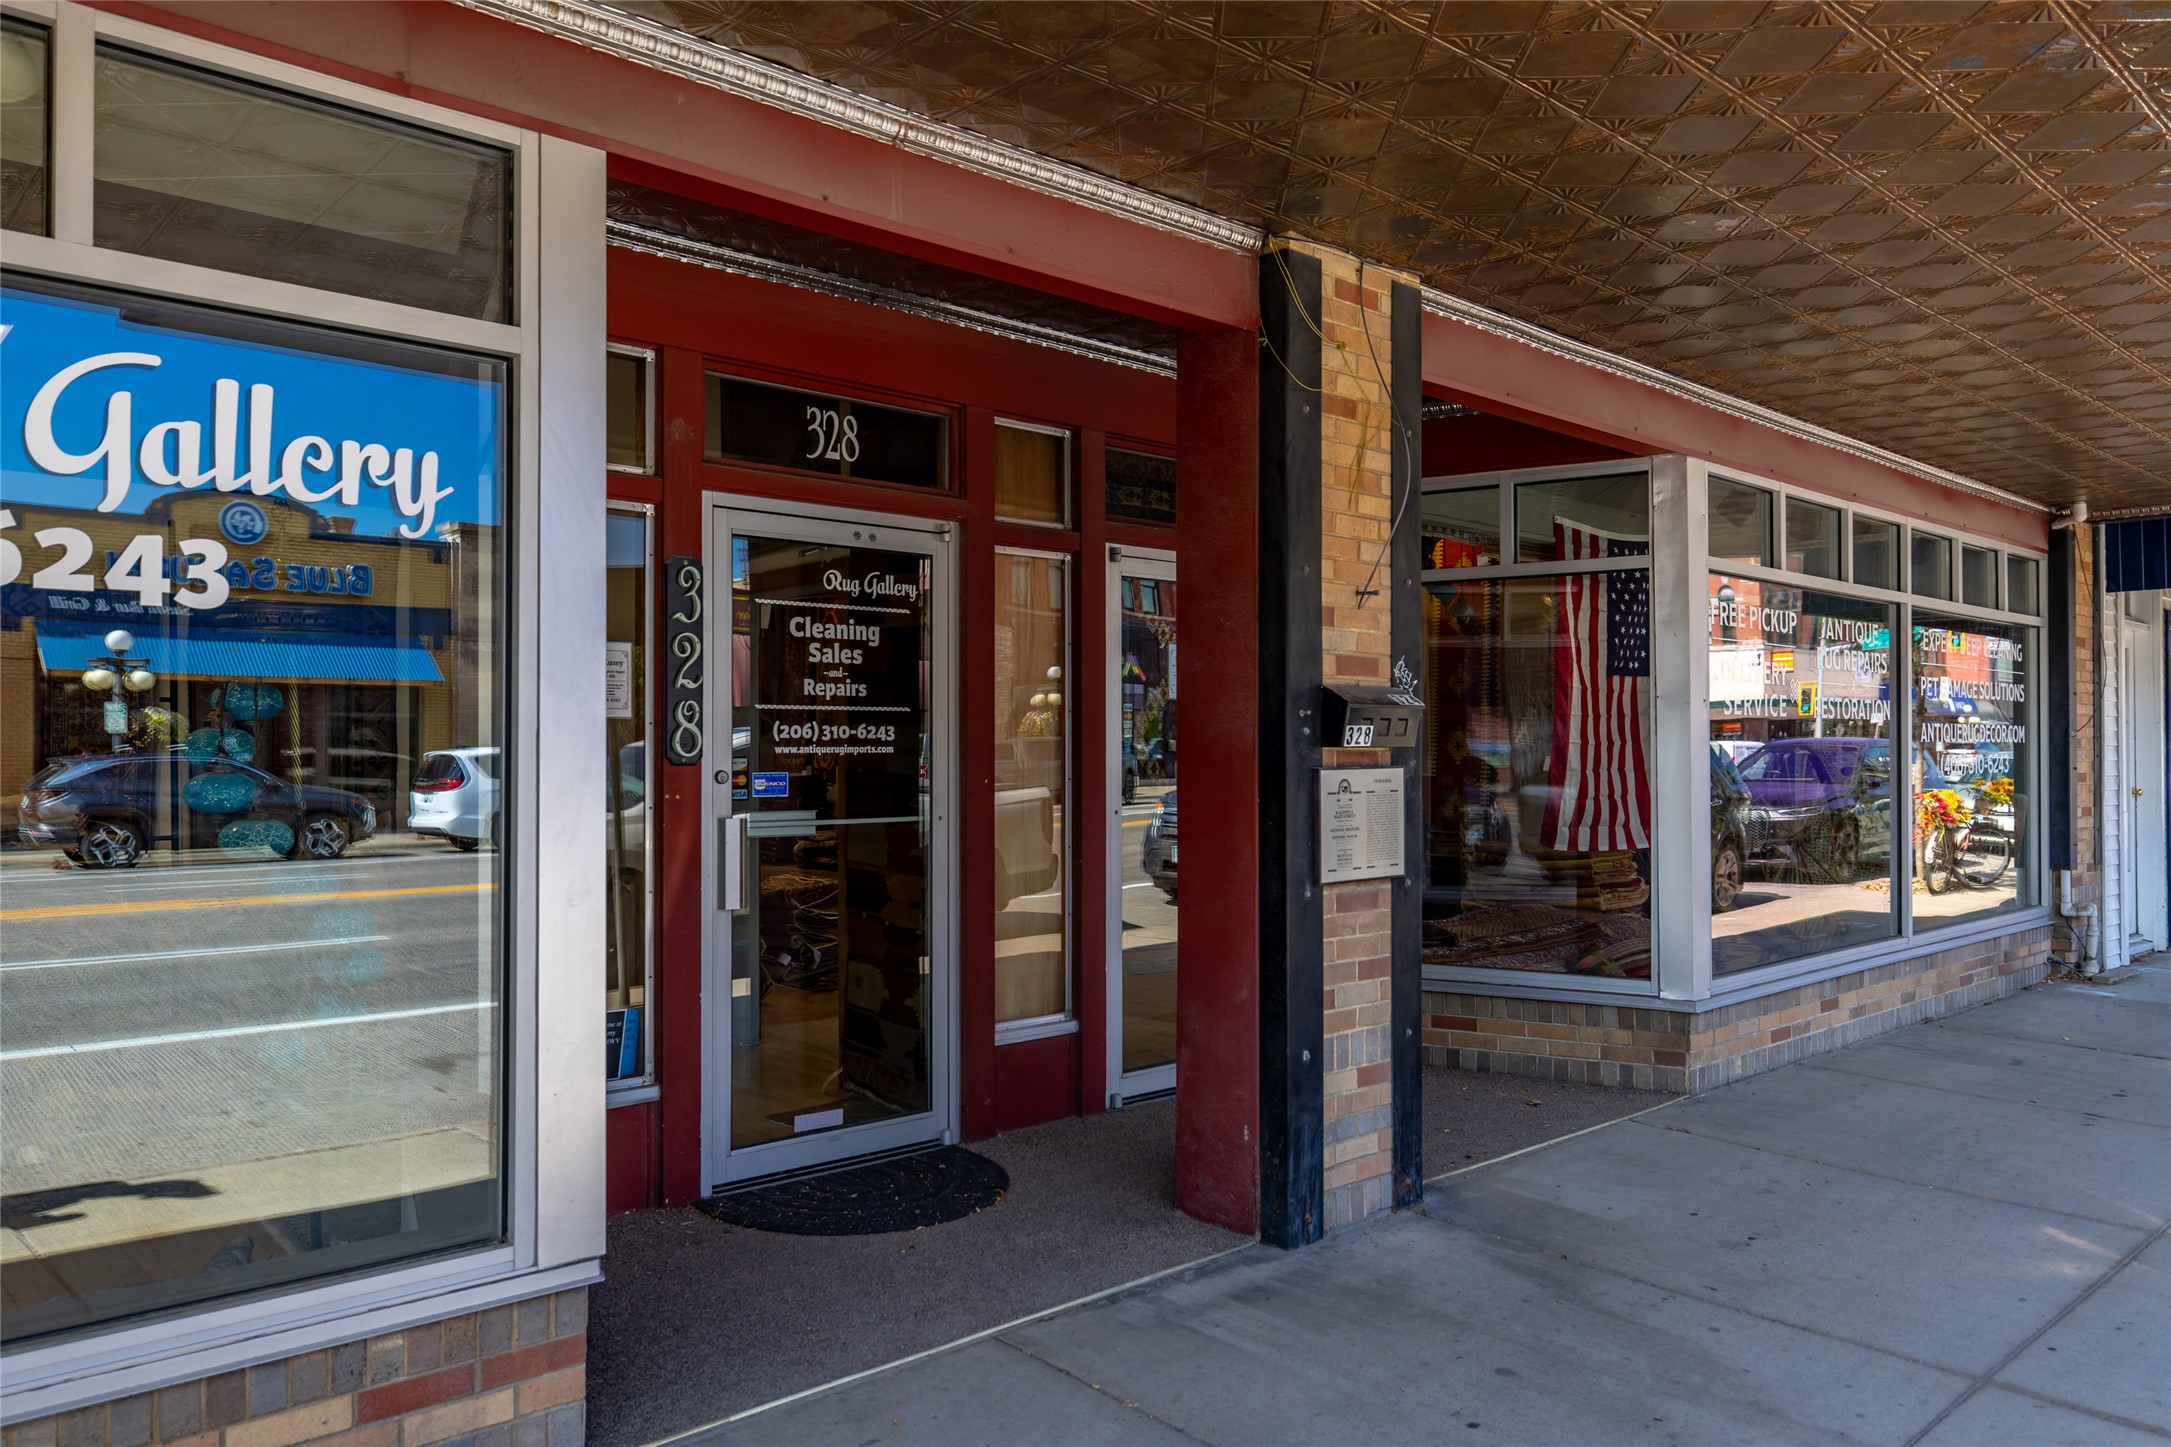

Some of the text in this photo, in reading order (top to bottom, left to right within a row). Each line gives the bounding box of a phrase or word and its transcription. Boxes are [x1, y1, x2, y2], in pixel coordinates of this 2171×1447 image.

[24, 351, 454, 539] Gallery
[806, 405, 860, 462] 328
[823, 569, 918, 601] Rug Gallery
[1711, 600, 1797, 634] FREE PICKUP
[789, 616, 880, 647] Cleaning
[1826, 617, 1879, 645] ANTIQUE
[808, 642, 863, 665] Sales
[1922, 631, 1958, 654] EXPERT
[1960, 636, 1983, 658] DEEP
[1983, 638, 2023, 662] CLEANING
[1816, 646, 1888, 674] RUG REPAIRS
[803, 678, 867, 700] Repairs
[1920, 676, 2025, 703] PET DAMAGE SOLUTIONS
[1723, 693, 1788, 717] SERVICE
[1813, 696, 1891, 721] RESTORATION
[772, 720, 895, 742] (206) 310-6243
[1346, 726, 1372, 746] 328
[1920, 722, 2026, 744] ANTIQUERUGDECOR.COM
[774, 744, 894, 755] www.antiquerugimports.com
[1969, 754, 2010, 775] 310-6243
